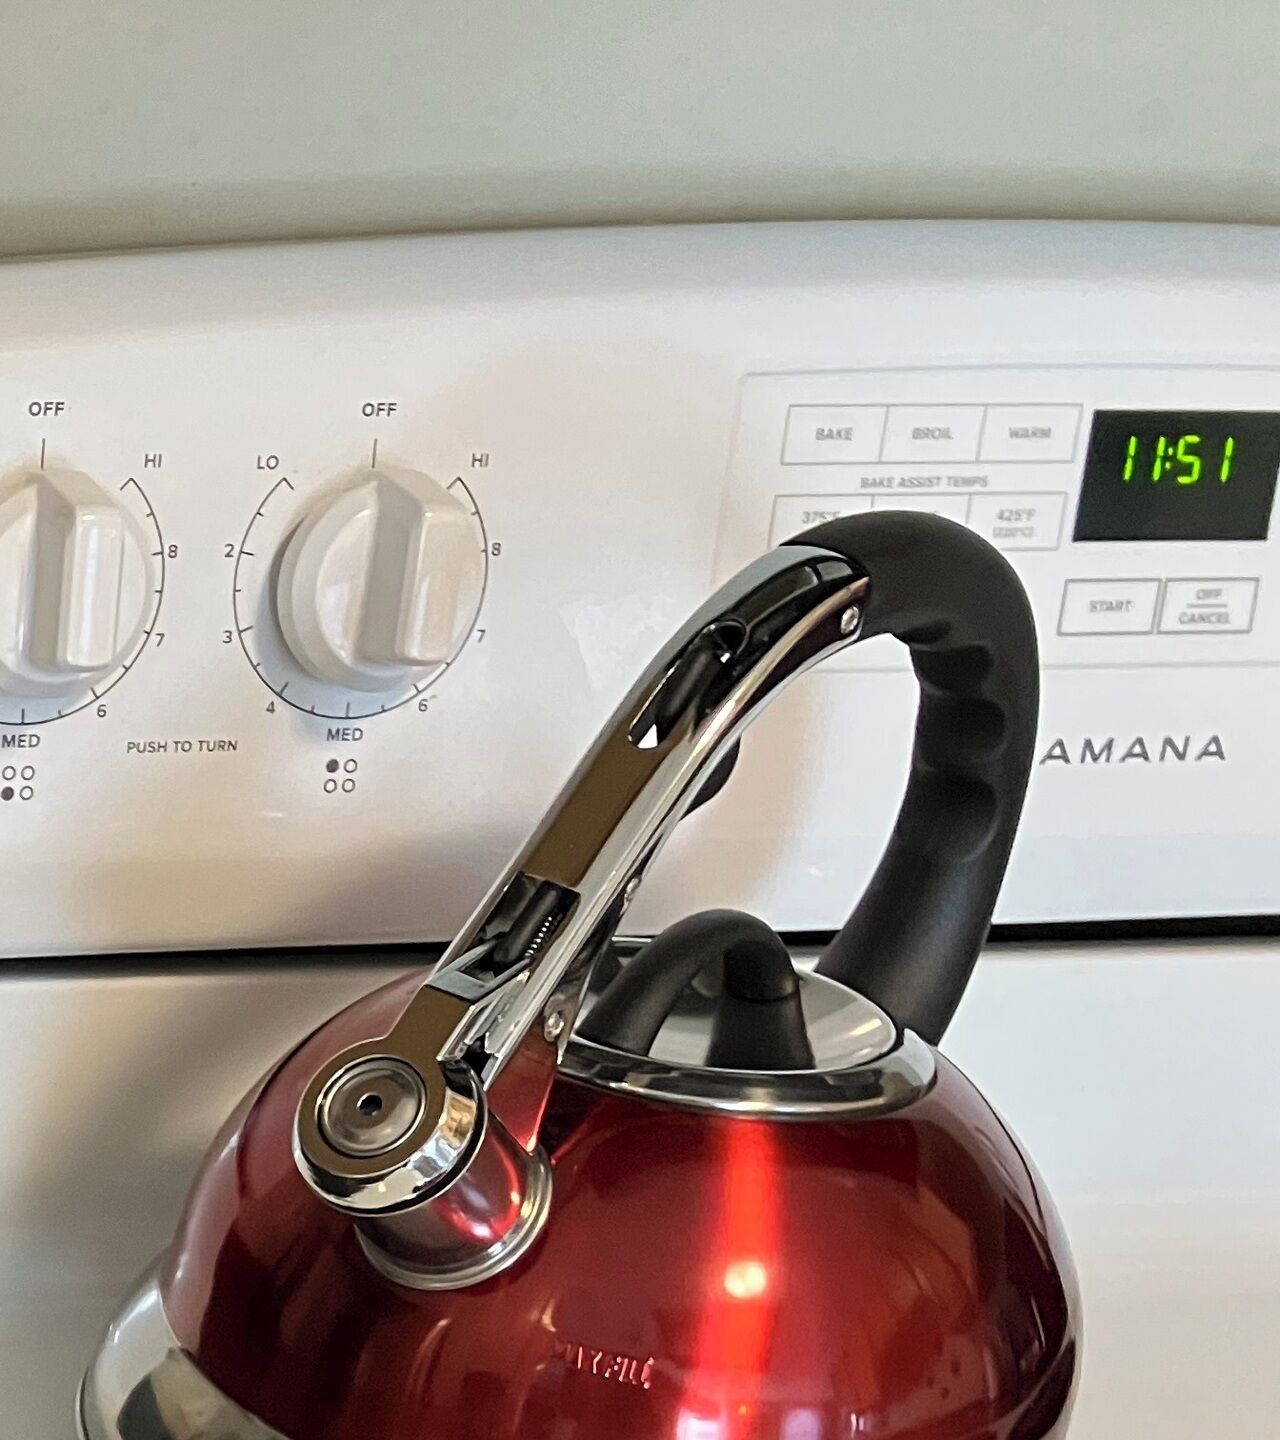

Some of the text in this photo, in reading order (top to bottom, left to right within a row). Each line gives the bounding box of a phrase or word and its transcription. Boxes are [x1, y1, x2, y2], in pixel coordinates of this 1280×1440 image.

[28, 401, 66, 417] OFF
[361, 402, 397, 418] OFF
[815, 427, 854, 441] BAKE
[912, 427, 954, 441] BROIL
[1008, 426, 1052, 440] WARM
[144, 452, 163, 469] HI
[256, 454, 279, 471] LO
[471, 452, 490, 468] HI
[1122, 434, 1235, 486] 11:51
[860, 475, 988, 489] BAKE ASSIST TEMPS
[167, 545, 178, 559] 8
[224, 544, 235, 559] 2
[491, 542, 501, 557] 8
[1195, 588, 1223, 600] OFF
[1089, 600, 1134, 613] START
[1178, 612, 1231, 624] CANCEL
[155, 634, 165, 648] 7
[222, 629, 233, 645] 3
[477, 628, 486, 643] 7
[96, 703, 106, 719] 6
[265, 700, 276, 716] 4
[418, 699, 428, 713] 6
[1, 733, 41, 750] MED
[326, 727, 364, 744] MED
[126, 738, 238, 754] PUSH TO TURN
[1039, 735, 1226, 766] AMANA
